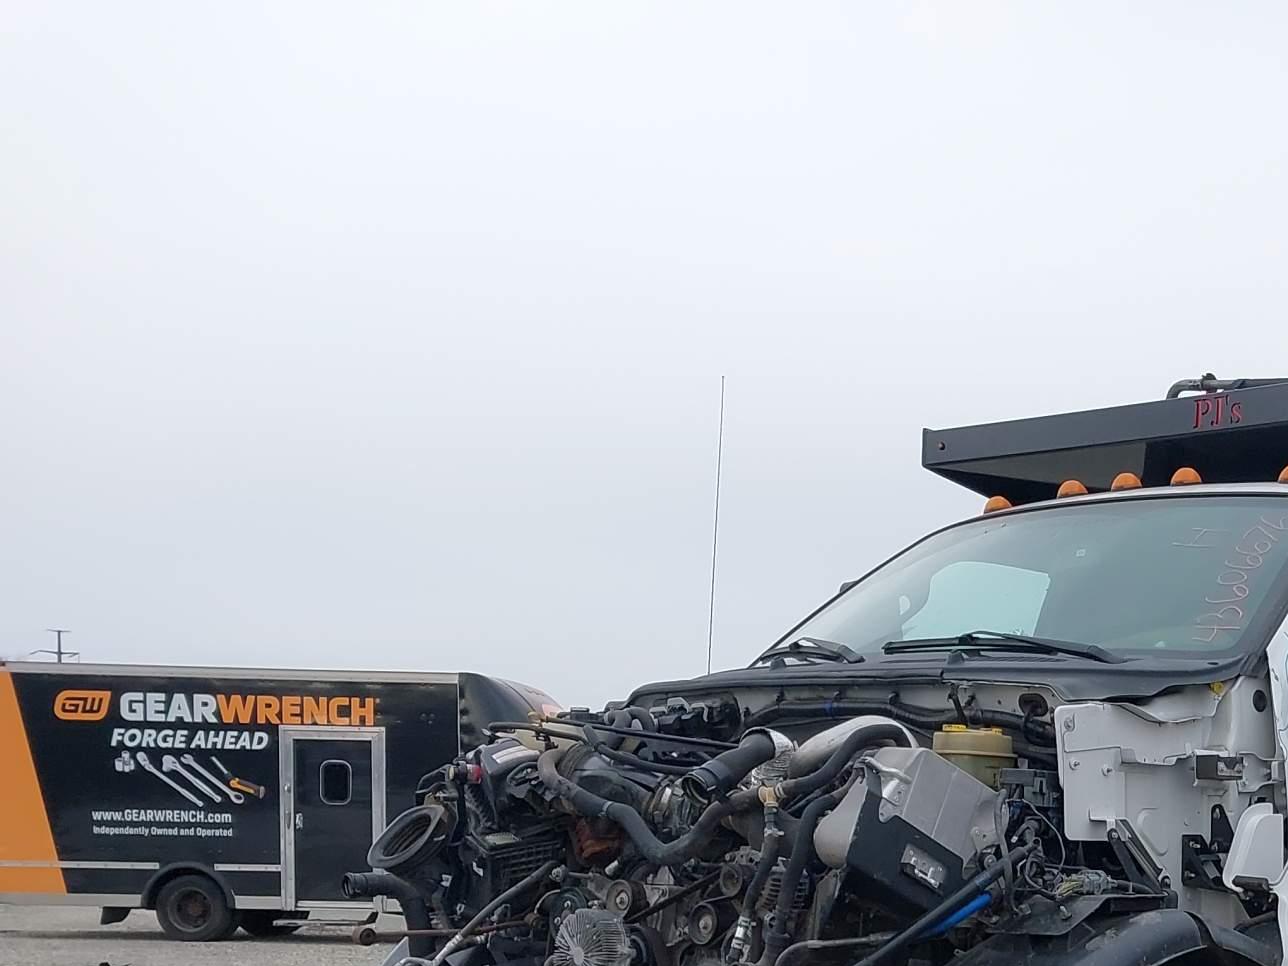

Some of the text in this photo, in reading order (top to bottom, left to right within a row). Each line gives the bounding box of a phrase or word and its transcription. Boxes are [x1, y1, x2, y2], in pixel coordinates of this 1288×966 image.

[1193, 394, 1242, 428] PJ's
[119, 692, 374, 726] GEARWRENCH
[110, 728, 269, 750] FORGE AHEAD
[91, 809, 233, 823] www.GEARWRENCH.com
[92, 825, 233, 838] Independently Owned and Operated
